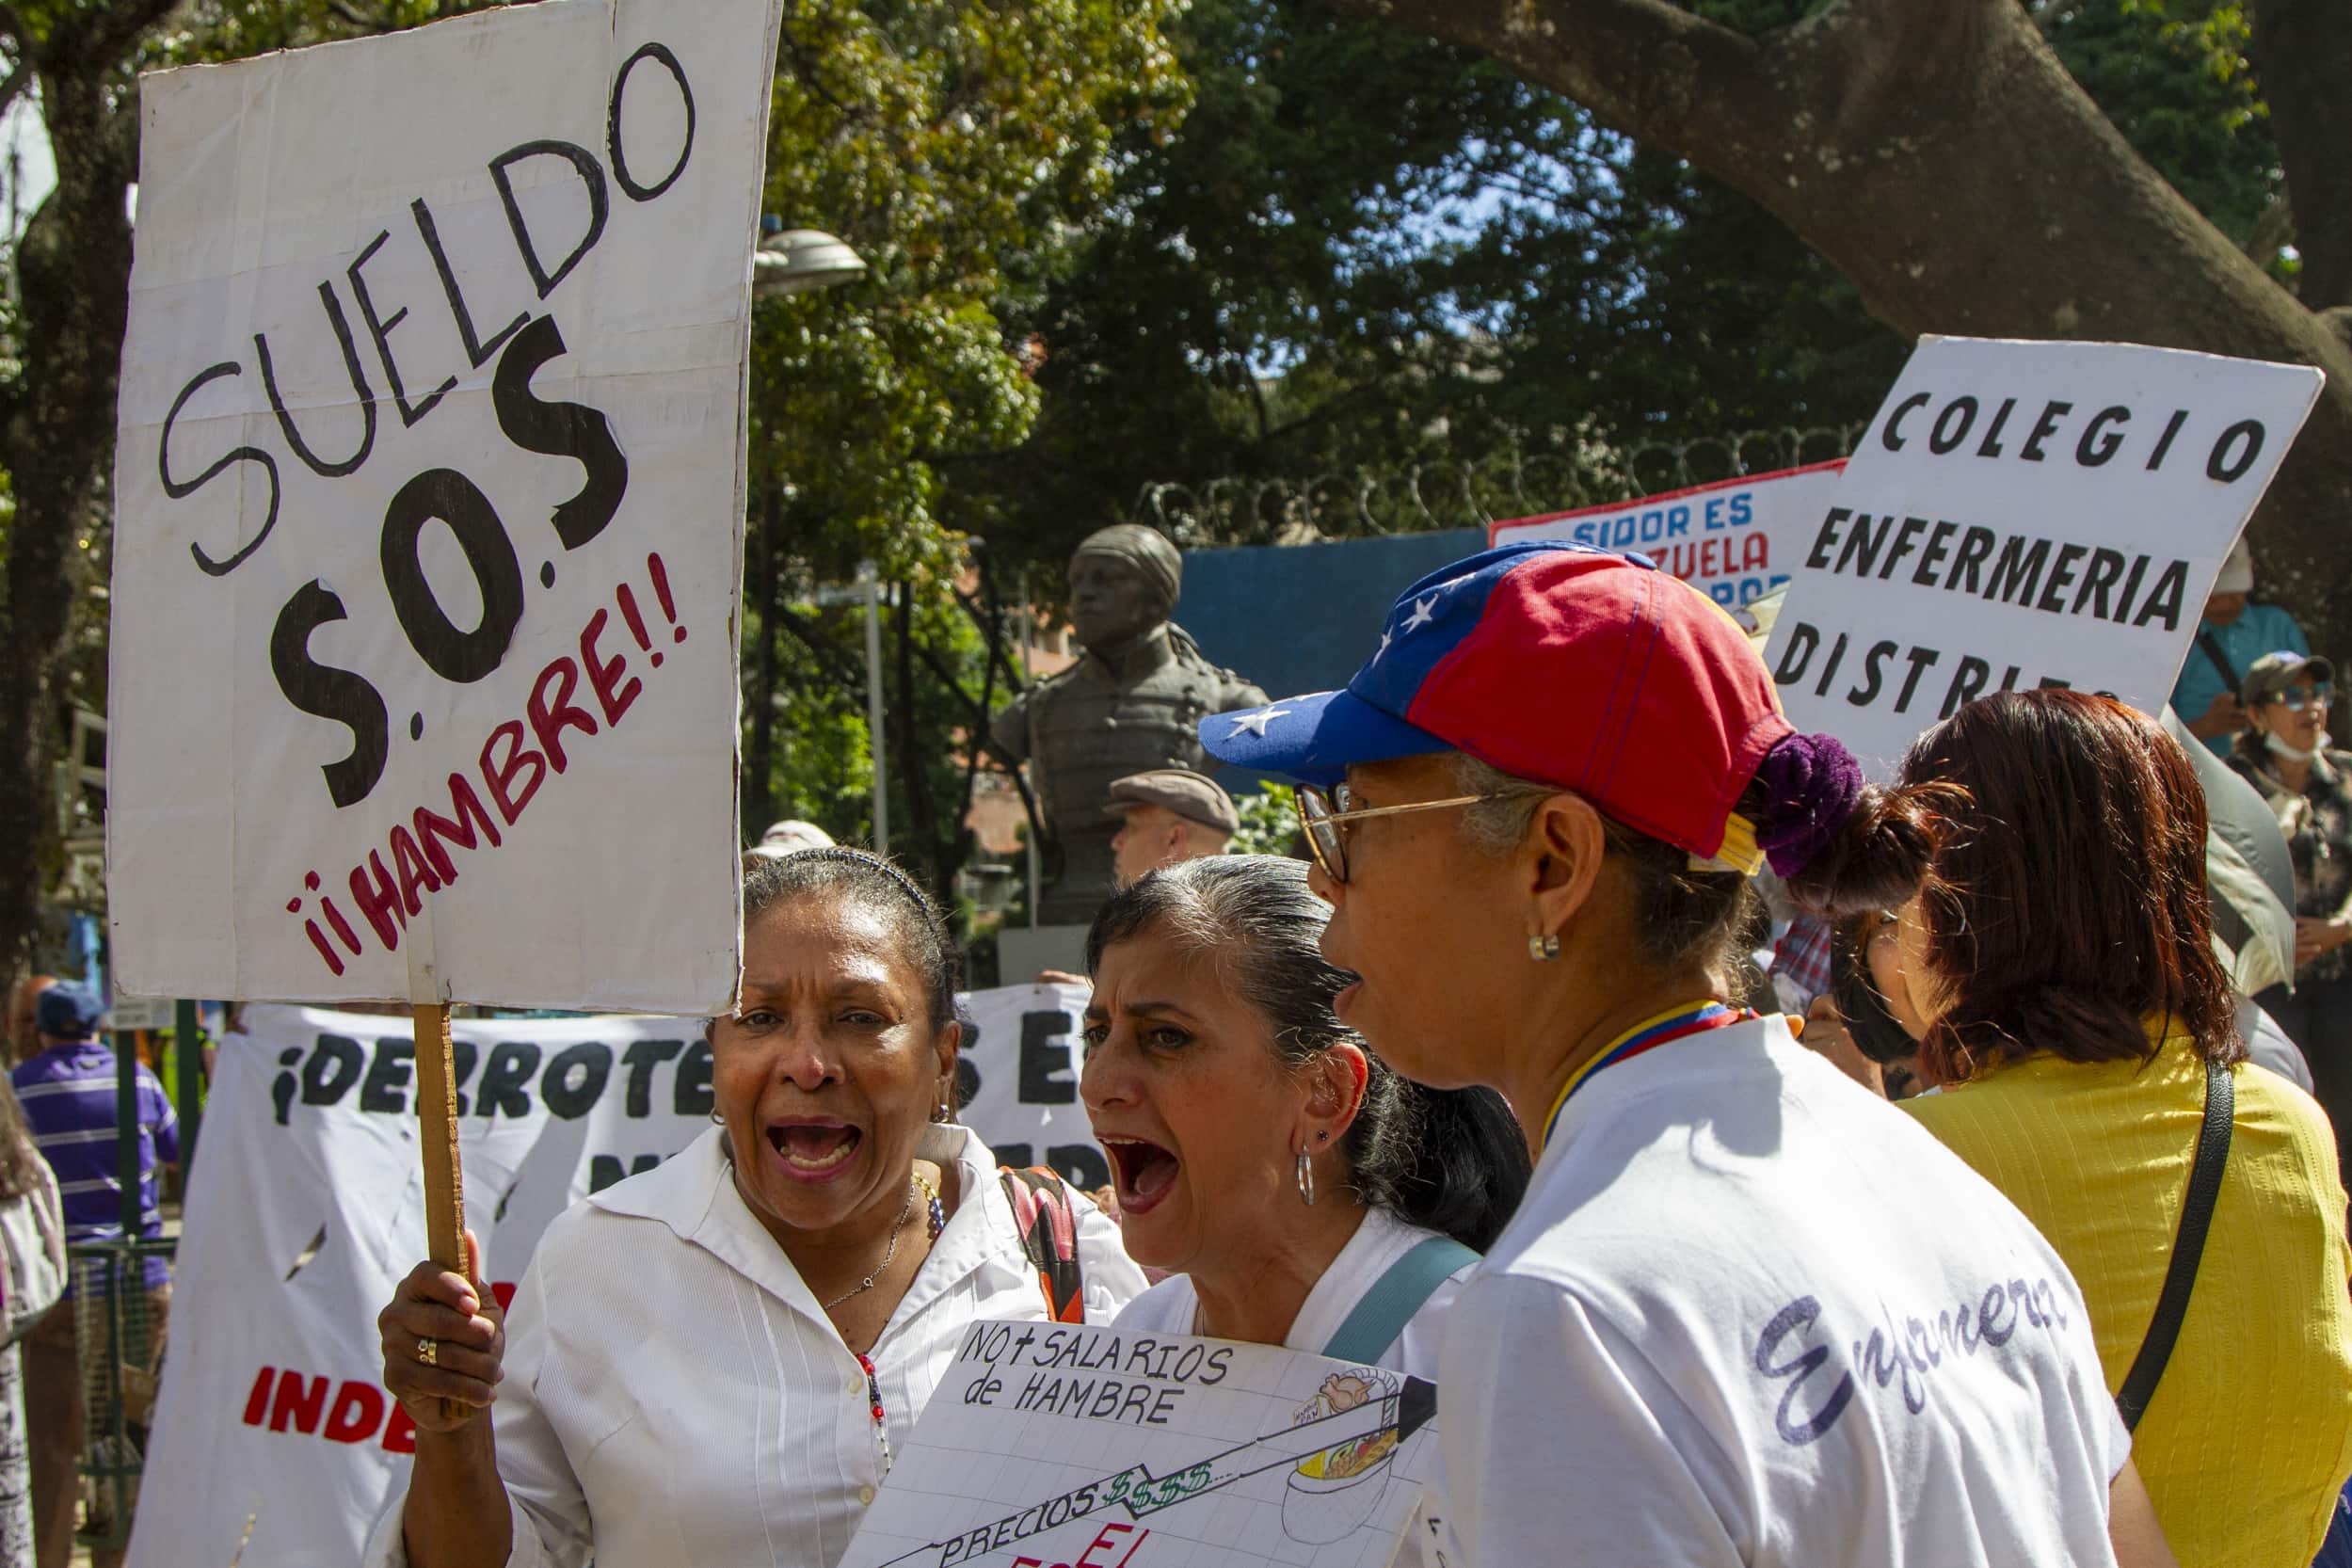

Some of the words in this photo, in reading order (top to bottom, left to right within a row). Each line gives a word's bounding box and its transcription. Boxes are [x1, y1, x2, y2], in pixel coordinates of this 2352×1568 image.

[159, 41, 696, 576] SUELDO
[1881, 392, 2267, 484] COLEGIO
[269, 313, 629, 808] S.O.S
[1573, 505, 1691, 548] SIDOR
[1704, 492, 1753, 531] ES
[1804, 507, 2191, 632] ENFERMERIA
[1773, 622, 2119, 721] DISTR
[286, 552, 688, 976] ¡¡HAMBRE!!
[964, 1363, 1001, 1405] de
[1015, 1371, 1185, 1424] HAMBRE
[938, 1481, 1100, 1568] PRECIOS
